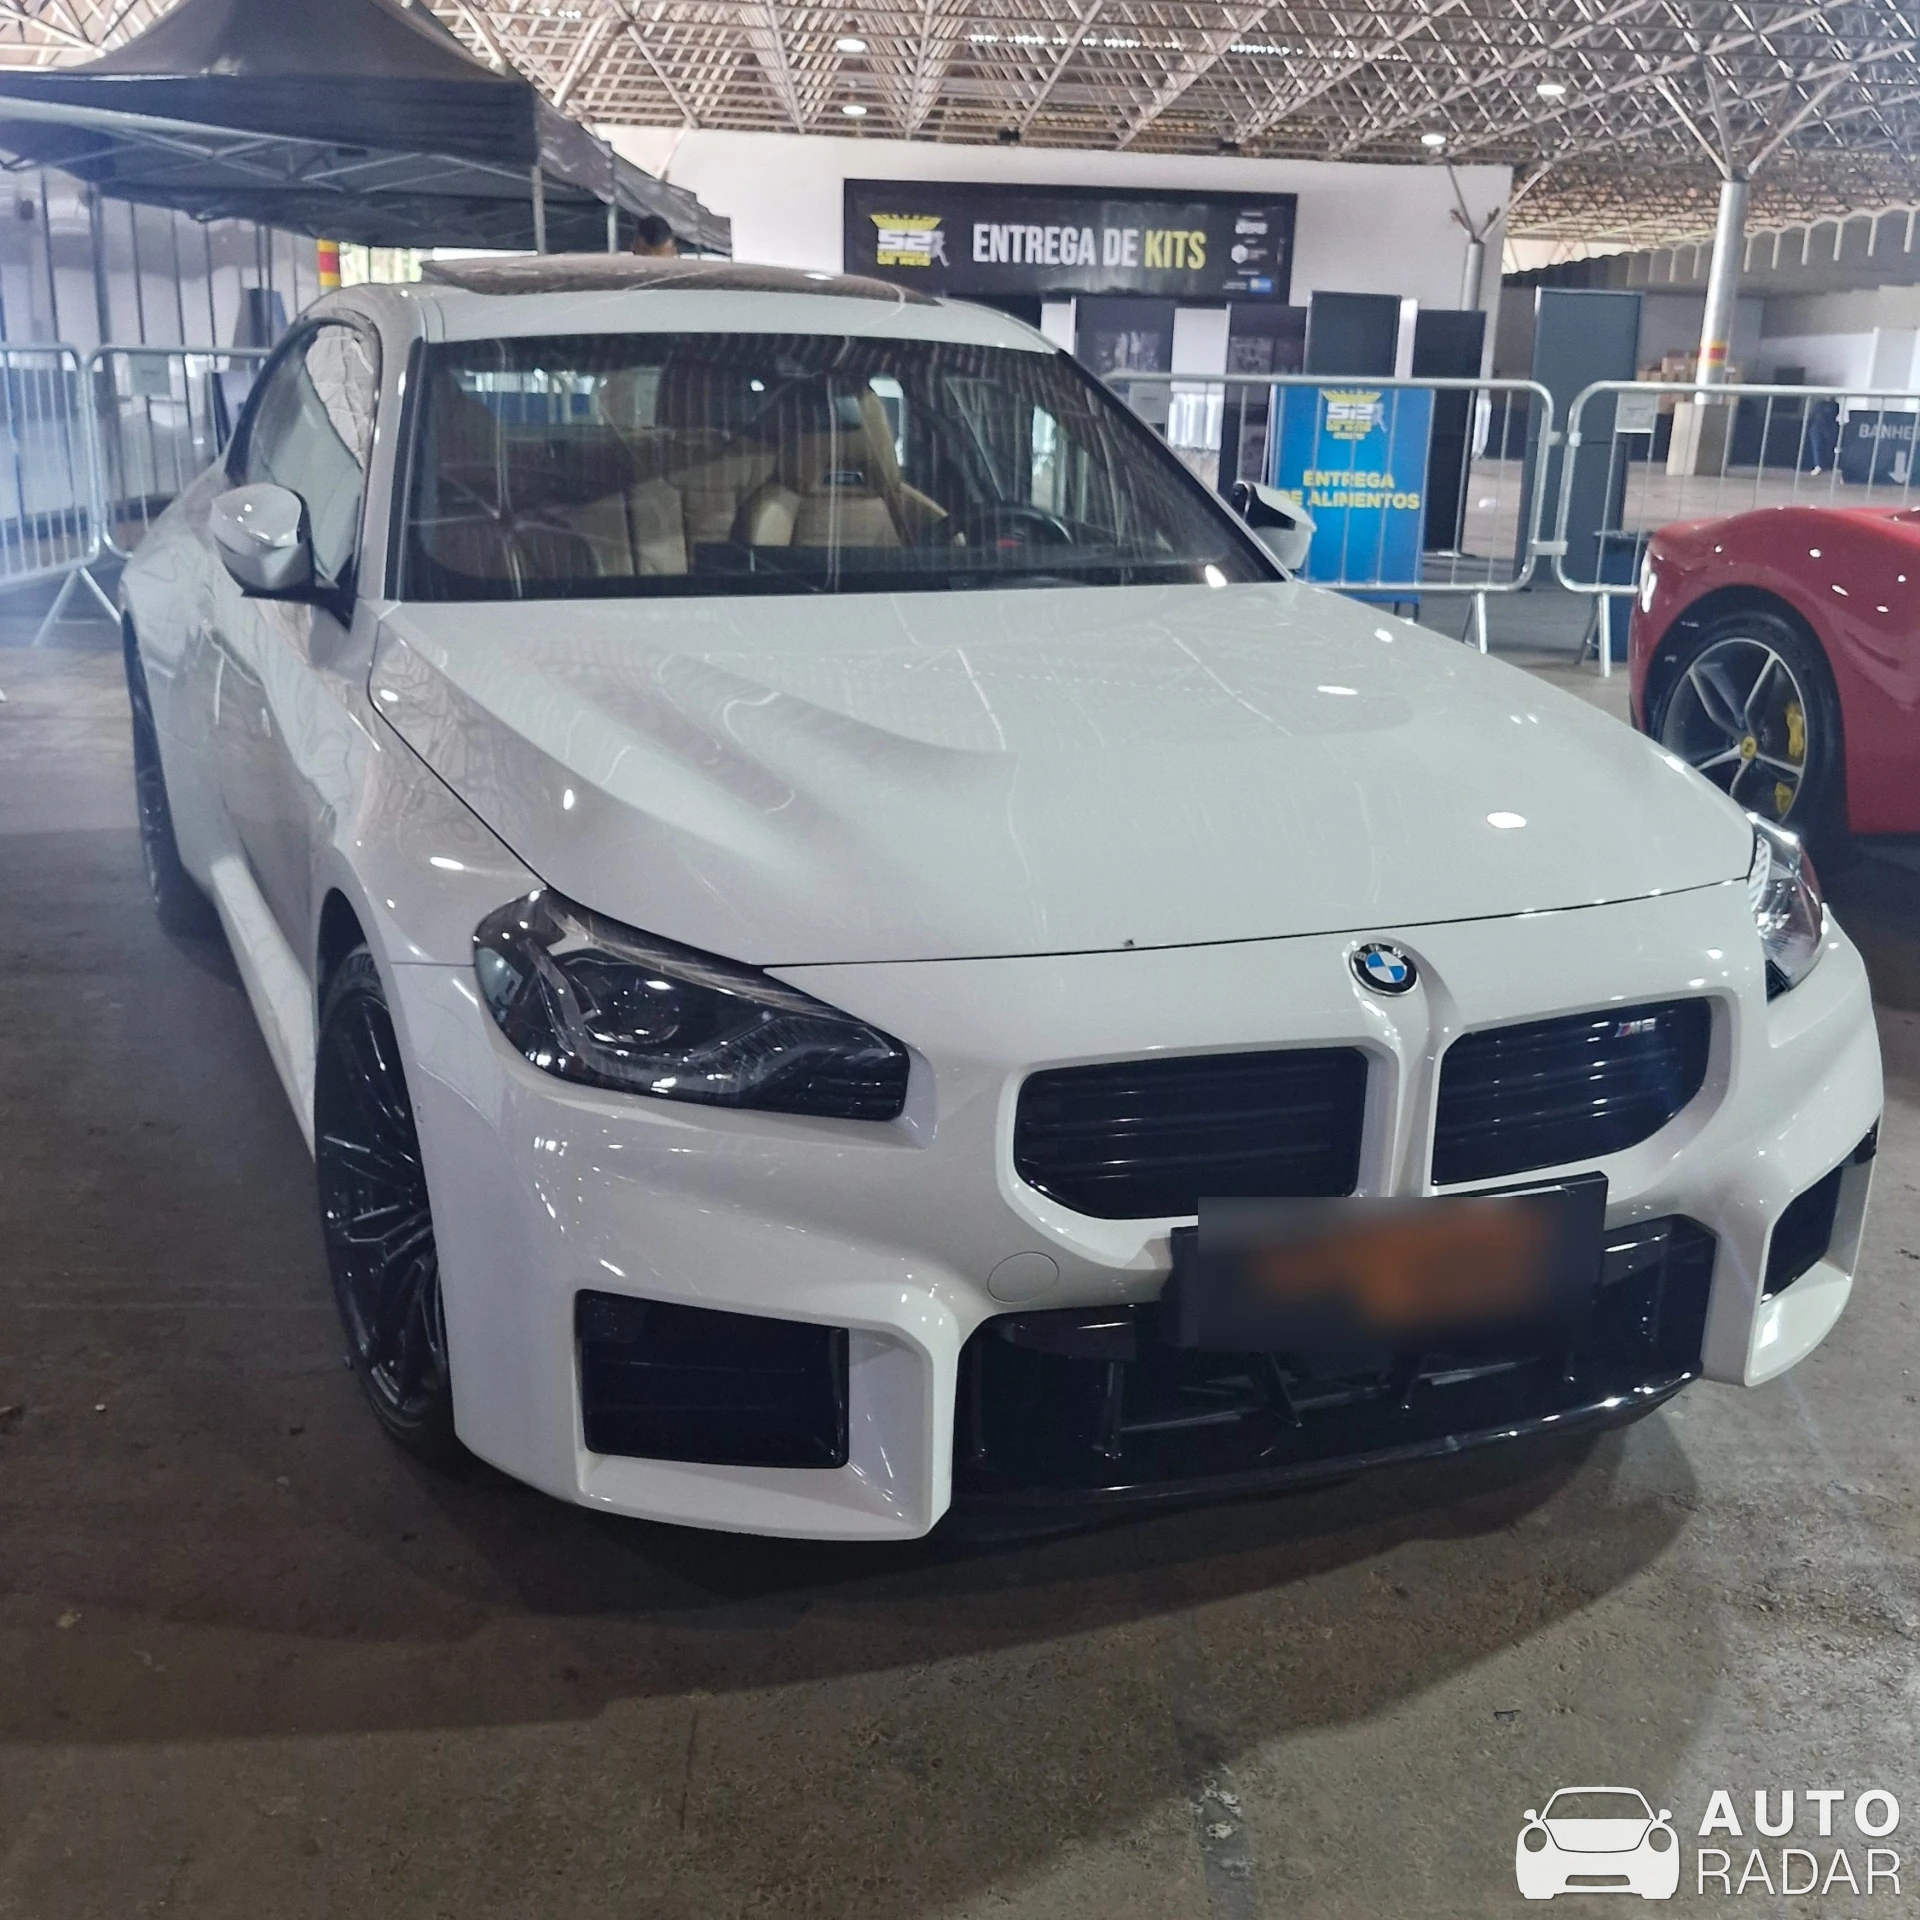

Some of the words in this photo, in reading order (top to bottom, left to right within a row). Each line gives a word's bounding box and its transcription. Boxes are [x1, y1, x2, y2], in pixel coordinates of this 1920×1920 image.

[972, 223, 1096, 266] ENTREGA
[1102, 228, 1139, 267] DE
[1144, 229, 1207, 270] KITS
[1302, 470, 1395, 489] ENTREGA
[1307, 490, 1421, 510] ALIMENTOS
